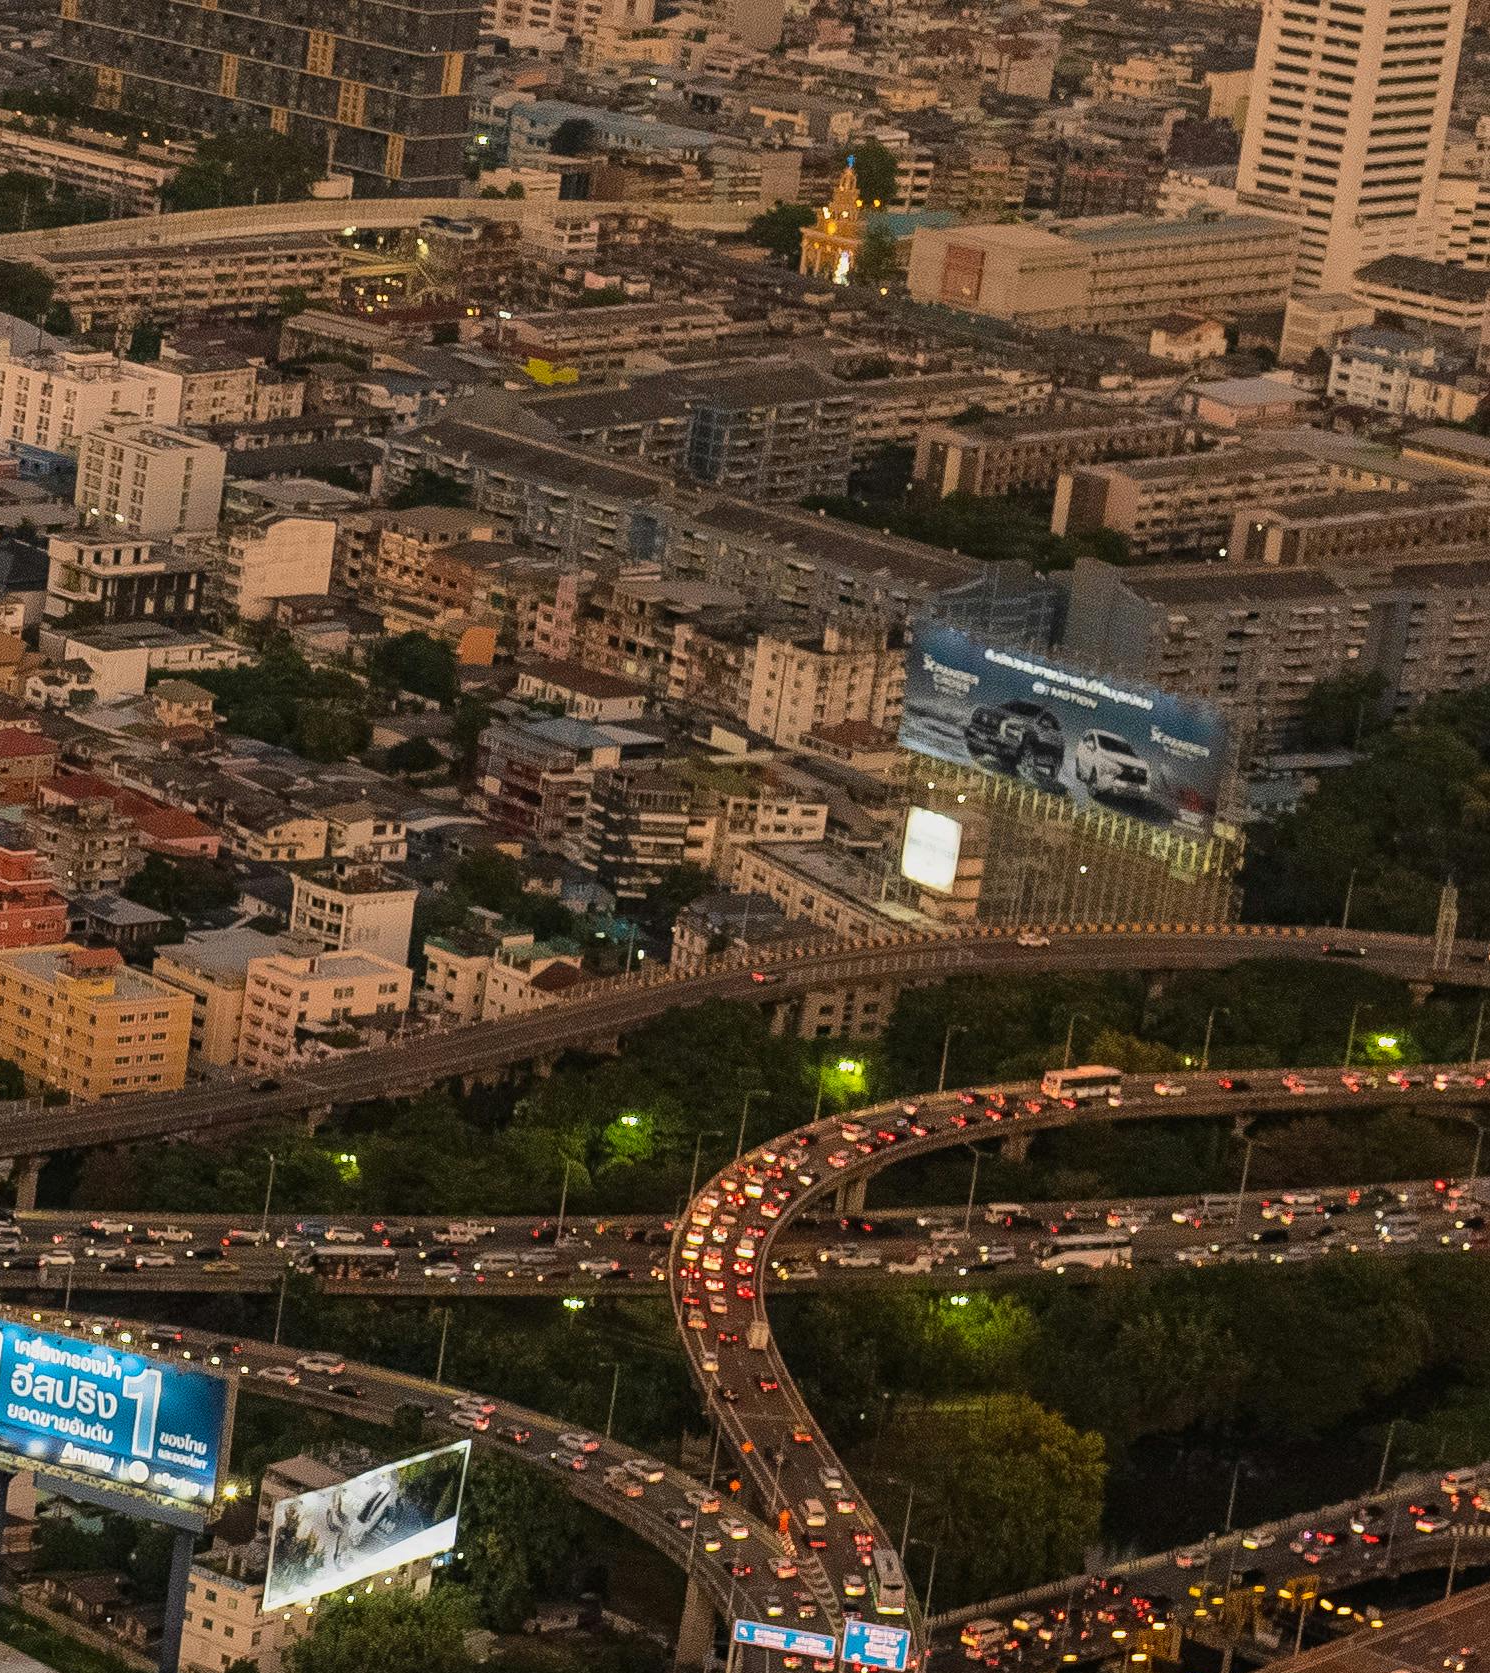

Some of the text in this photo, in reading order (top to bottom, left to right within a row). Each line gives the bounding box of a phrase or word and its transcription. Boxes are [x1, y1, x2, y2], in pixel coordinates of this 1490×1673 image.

[11, 1363, 118, 1419] อีสปริง
[7, 1369, 162, 1459] ยอดขายอันดับ 1
[59, 1442, 114, 1473] Amway
[160, 1432, 207, 1455] ของไทย
